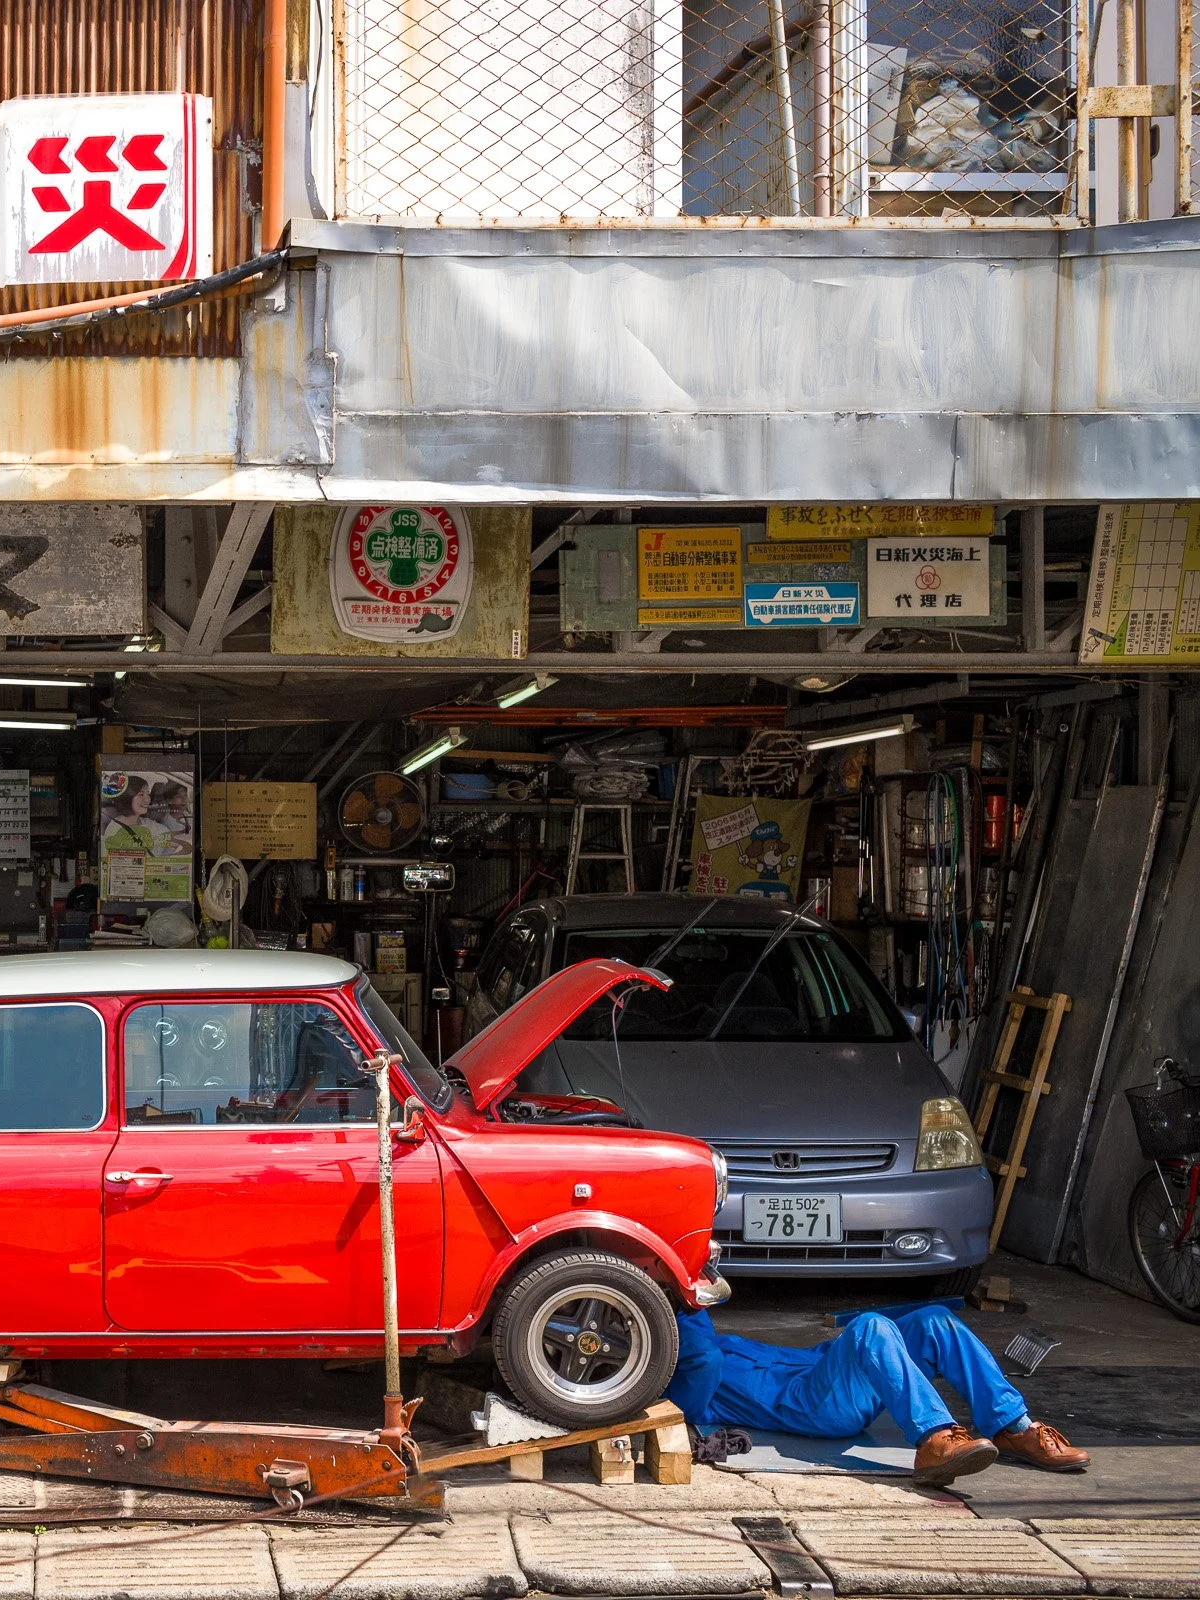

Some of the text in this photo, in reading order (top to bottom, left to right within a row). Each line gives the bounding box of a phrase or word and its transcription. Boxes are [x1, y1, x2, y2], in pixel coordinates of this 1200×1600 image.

[359, 515, 369, 526] 10
[394, 514, 418, 526] JSS
[443, 519, 452, 529] 2
[352, 541, 360, 551] 9
[371, 536, 439, 559] 点検整備済
[450, 545, 458, 555] 3
[876, 547, 981, 561] 日新火災海上
[358, 567, 366, 577] 8
[442, 572, 450, 580] 4
[375, 586, 383, 596] 7
[424, 587, 432, 597] 5
[782, 590, 823, 598] 日新火災
[399, 593, 407, 603] 6
[895, 594, 962, 608] 代理店
[753, 604, 851, 615] 自動車損害賠償責任保険代理店
[768, 1198, 819, 1211] 足立 502
[751, 1214, 831, 1237] つ 78-71
